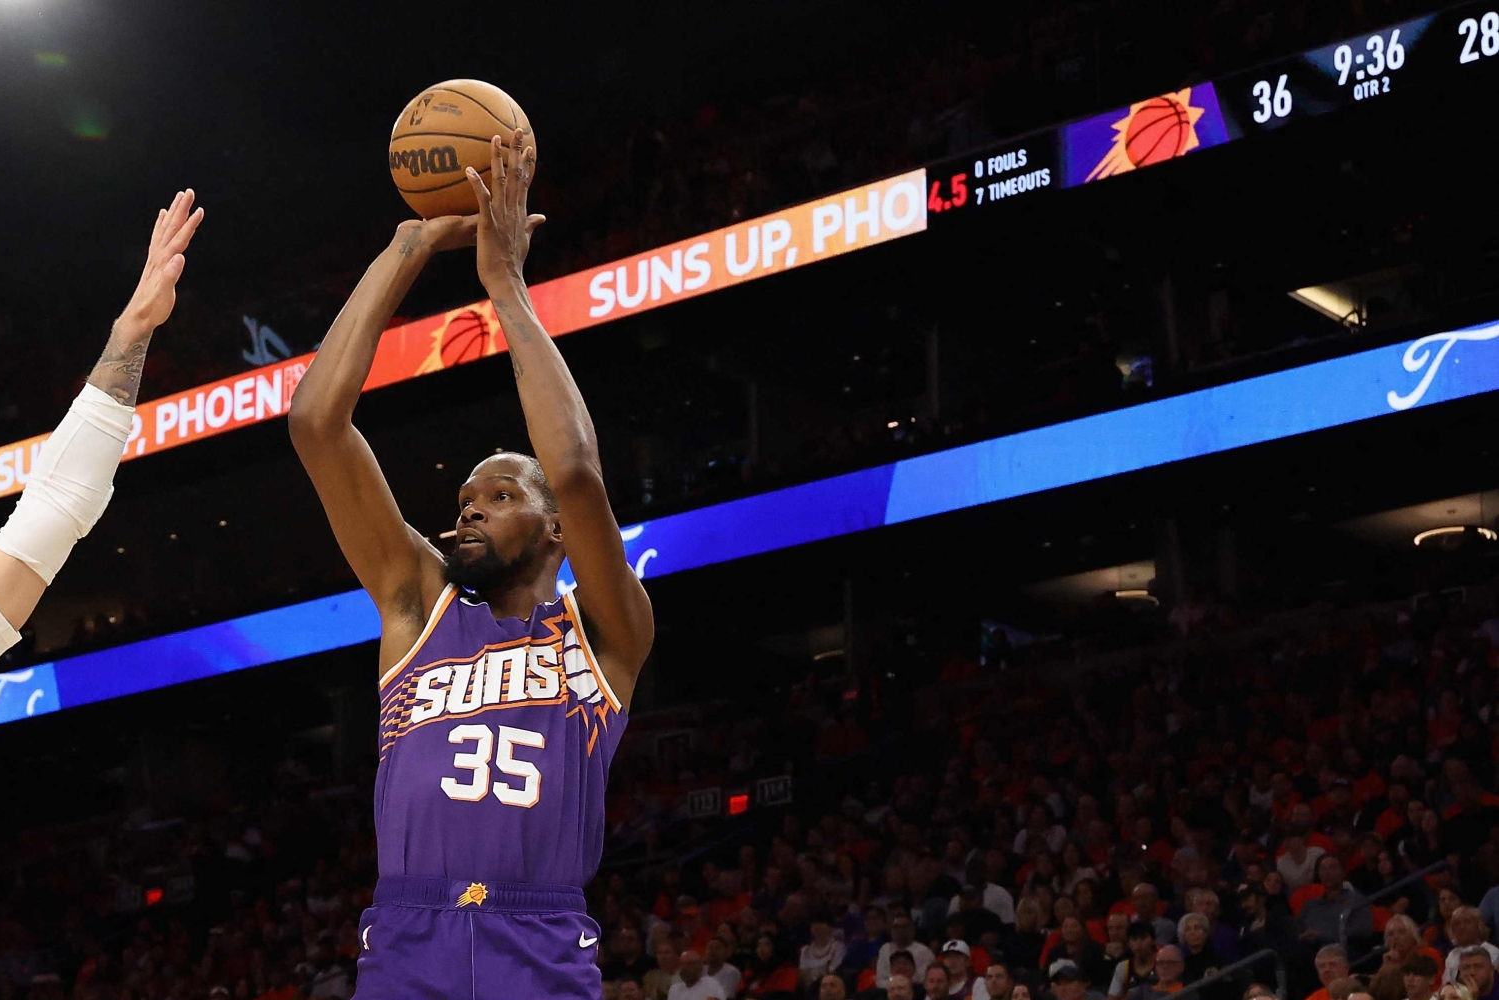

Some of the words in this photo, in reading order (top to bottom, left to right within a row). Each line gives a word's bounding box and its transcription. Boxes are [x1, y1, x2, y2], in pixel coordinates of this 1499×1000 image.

[1333, 28, 1405, 86] 9:36
[1458, 11, 1498, 64] 28
[1252, 74, 1293, 124] 36
[1353, 79, 1380, 101] QTR
[1382, 76, 1391, 93] 2
[974, 160, 984, 179] 0
[987, 148, 1028, 176] FOULS
[975, 187, 985, 206] 7
[987, 168, 1051, 202] TIMEOUTS
[589, 242, 712, 318] SUNS
[724, 218, 798, 277] UP,
[812, 180, 927, 254] PHO
[410, 645, 561, 724] SUNS
[440, 723, 547, 809] 35
